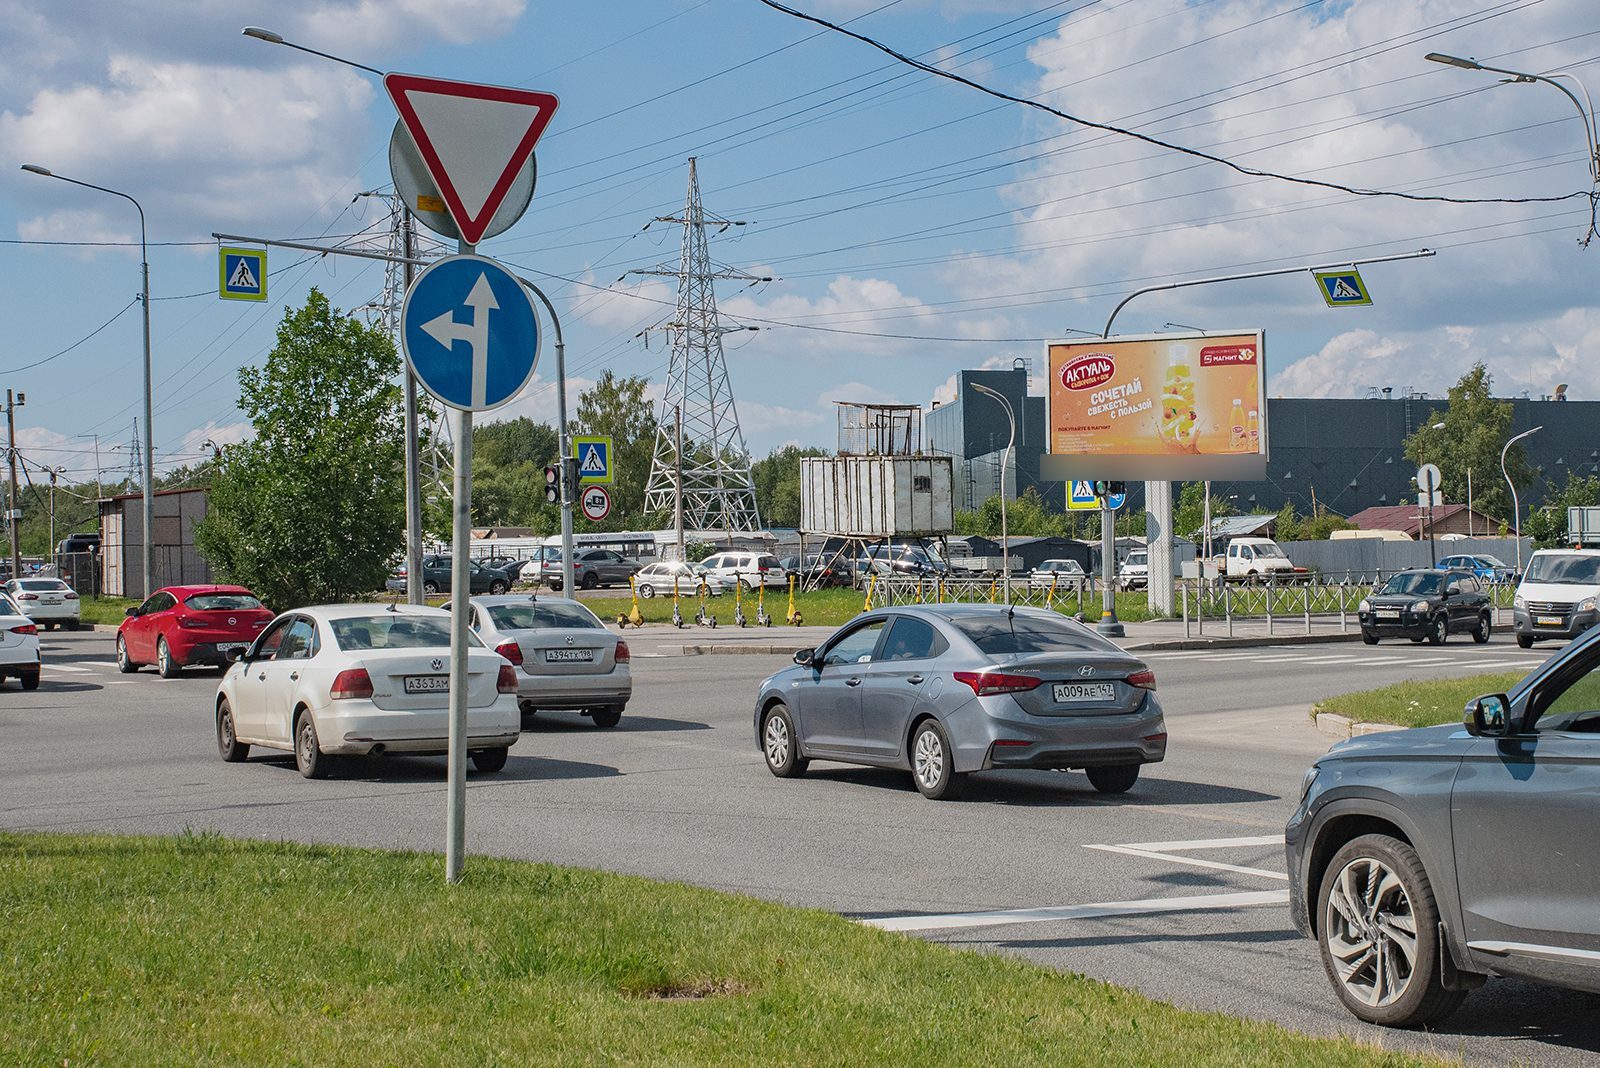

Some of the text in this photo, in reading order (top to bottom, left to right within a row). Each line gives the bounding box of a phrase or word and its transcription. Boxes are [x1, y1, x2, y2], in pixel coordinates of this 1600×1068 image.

[1066, 360, 1111, 384] АКТУАЛЬ
[1090, 377, 1142, 405] СОЧЕТАЙ
[1087, 398, 1128, 417] СВЕЖЕСТЬ
[1110, 398, 1153, 419] С ПОЛЬЗОЙ
[549, 650, 578, 659] А394ТХ
[408, 678, 448, 689] А363АМ
[1057, 684, 1111, 698] А009АЕ 147
